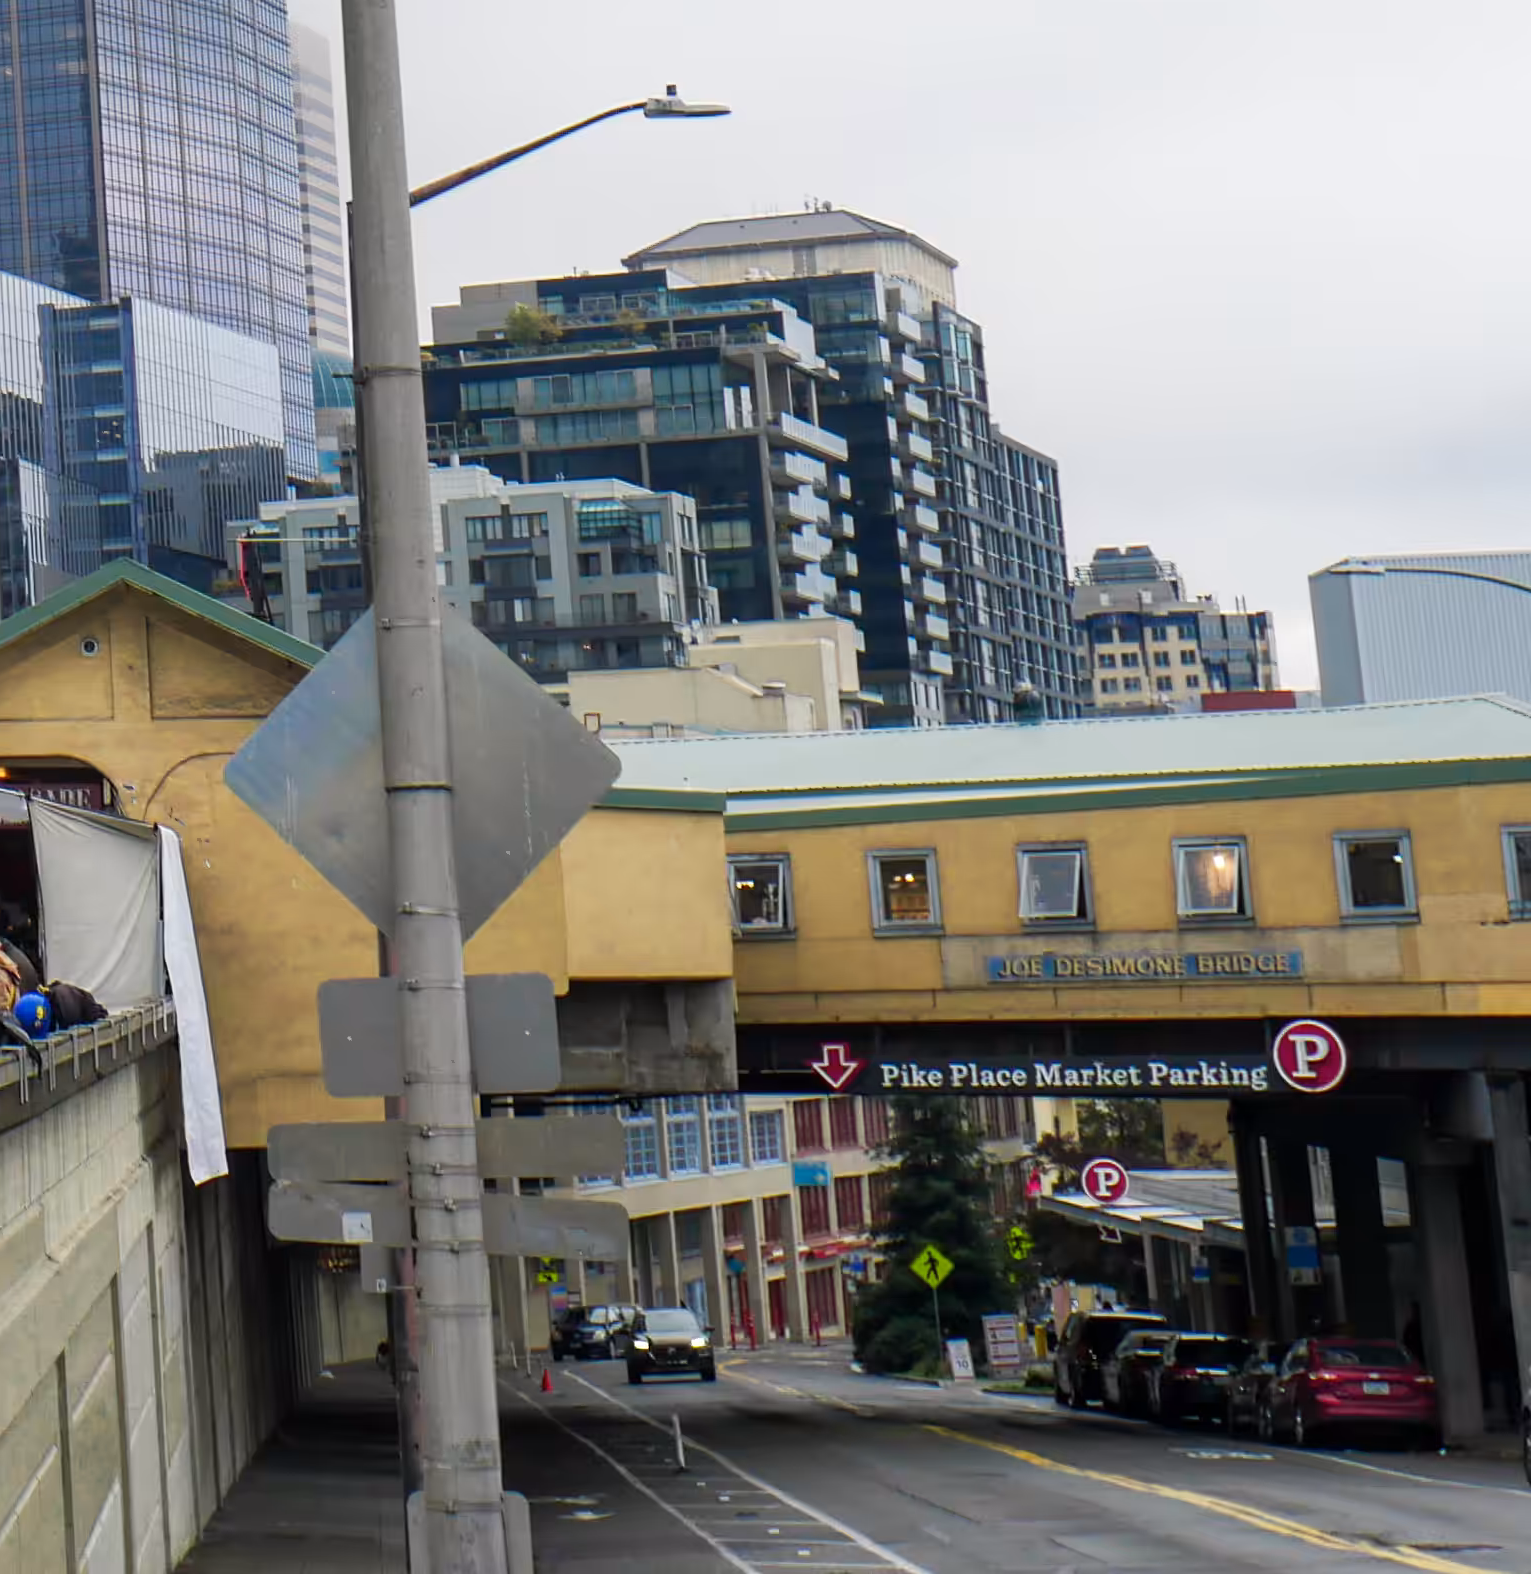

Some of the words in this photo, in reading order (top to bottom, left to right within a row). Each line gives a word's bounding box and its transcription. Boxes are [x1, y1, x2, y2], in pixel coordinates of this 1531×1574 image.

[998, 957, 1043, 977] JOE
[1054, 954, 1185, 976] DESIMONE
[1197, 953, 1289, 974] BRIDGE
[880, 1063, 943, 1088] Pike
[949, 1062, 1027, 1088] Place
[1033, 1061, 1141, 1088] Market
[1147, 1061, 1268, 1091] Parking
[1287, 1033, 1330, 1079] P
[1092, 1167, 1120, 1197] P
